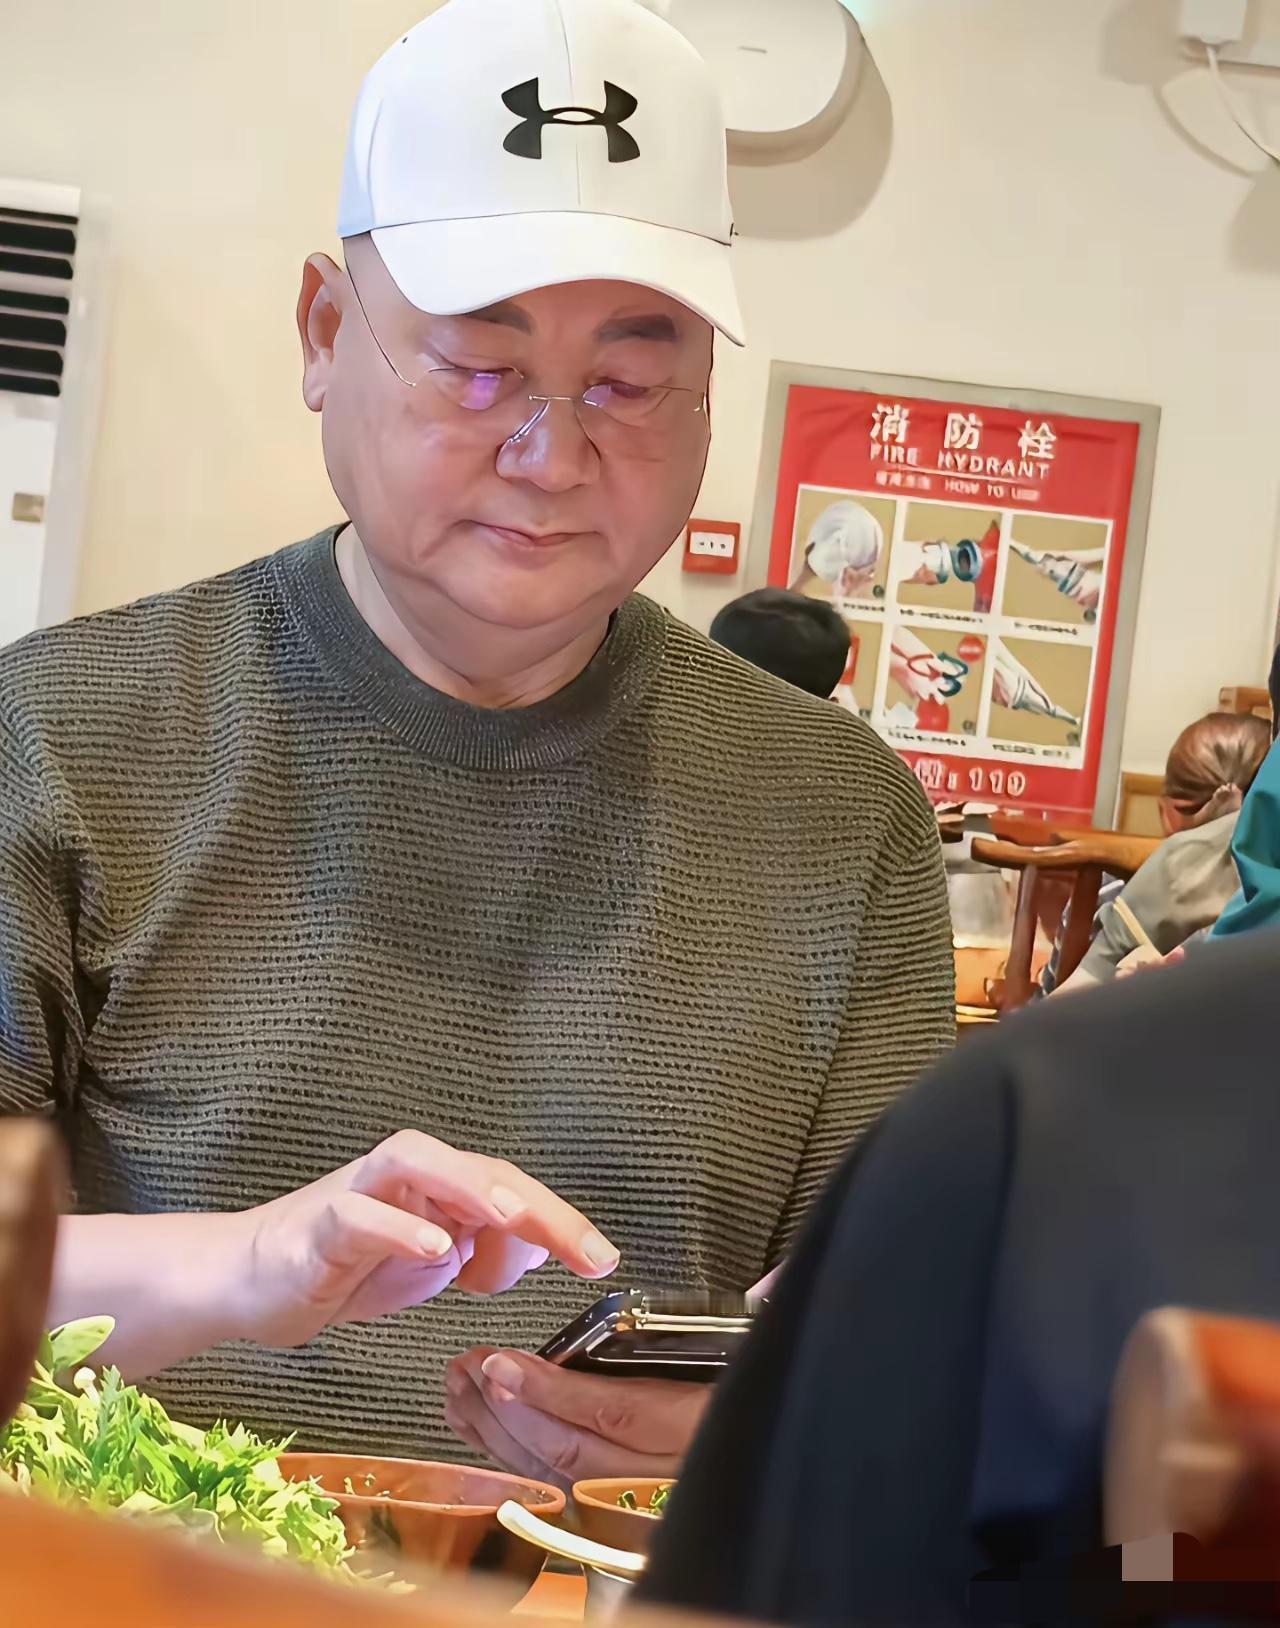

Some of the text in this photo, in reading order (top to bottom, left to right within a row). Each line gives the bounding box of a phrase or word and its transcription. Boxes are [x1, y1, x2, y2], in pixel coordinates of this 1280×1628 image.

[869, 403, 1057, 460] 消防栓
[870, 443, 1050, 479] FIRE HYDRANT
